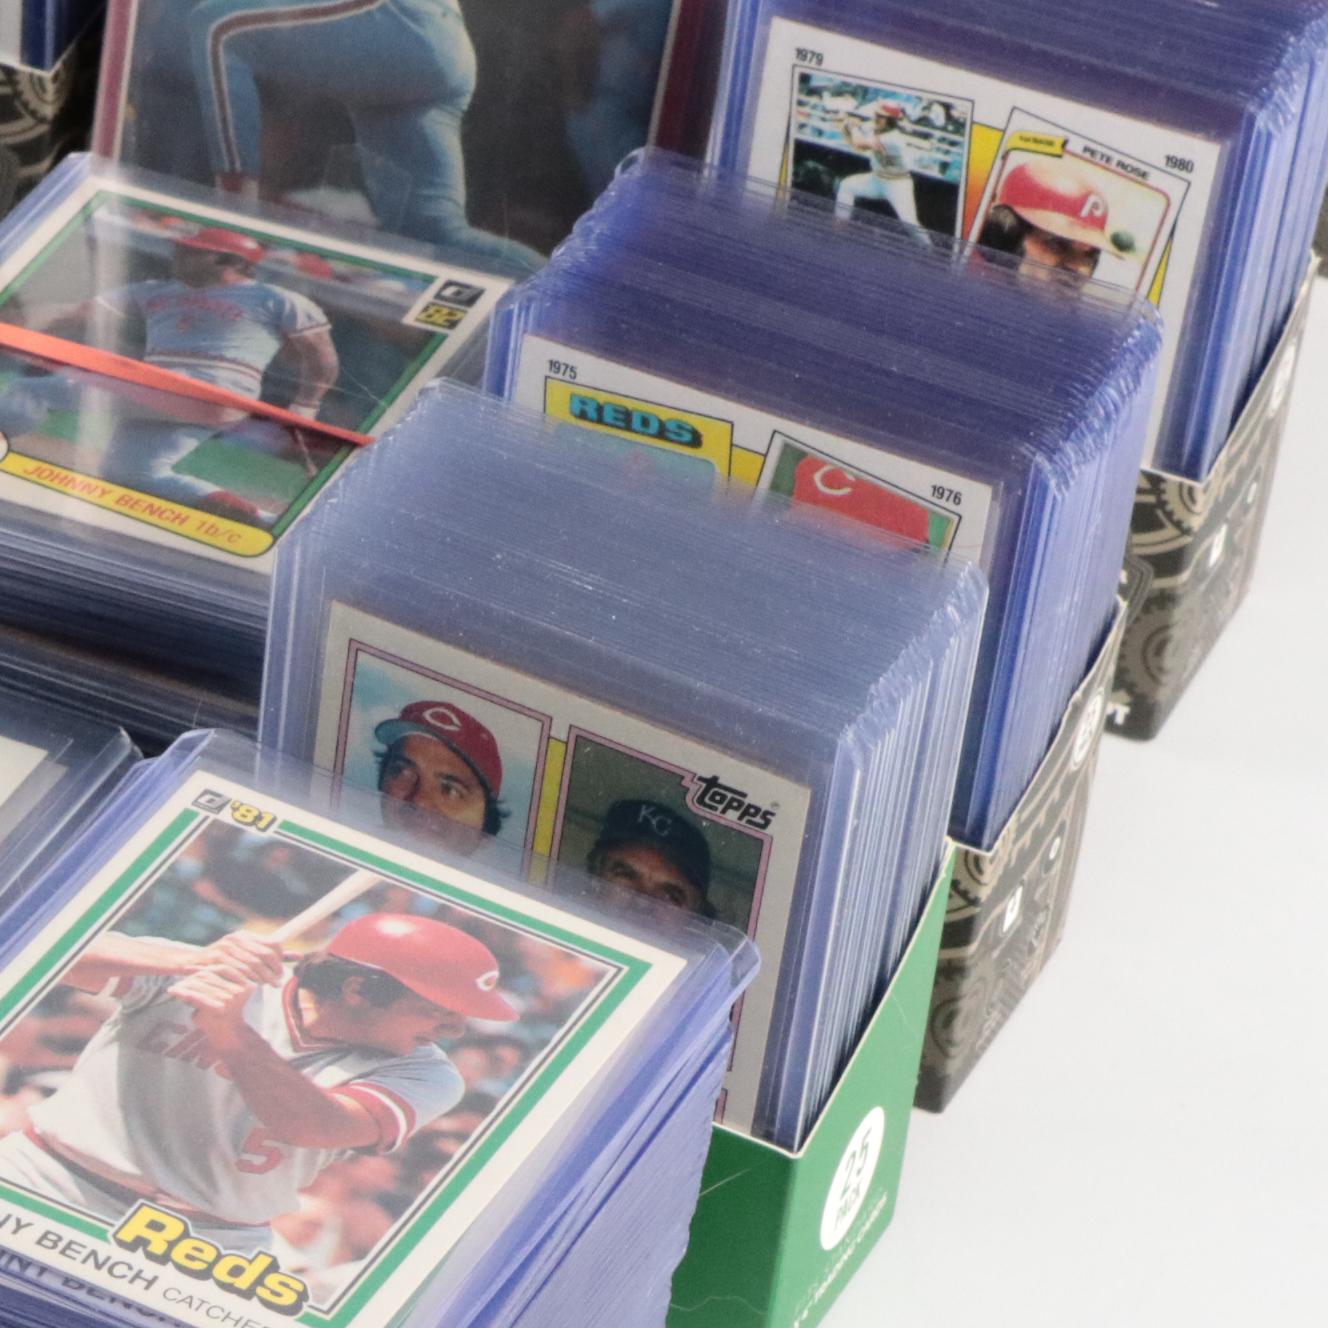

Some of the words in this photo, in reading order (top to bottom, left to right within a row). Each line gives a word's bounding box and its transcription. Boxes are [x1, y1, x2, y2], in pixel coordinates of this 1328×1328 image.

[795, 48, 824, 66] 1979
[1083, 145, 1113, 167] PETE
[1115, 161, 1150, 181] ROSE
[1164, 154, 1195, 174] 1980
[547, 358, 578, 381] 1975
[569, 393, 703, 449] REDS
[22, 464, 116, 499] JOHNNY
[114, 493, 188, 527] BENCH
[194, 518, 243, 545] 1b/c
[931, 484, 962, 507] 1976
[230, 800, 278, 833] '81
[35, 1229, 161, 1291] BENCH
[113, 1202, 309, 1316] Reds
